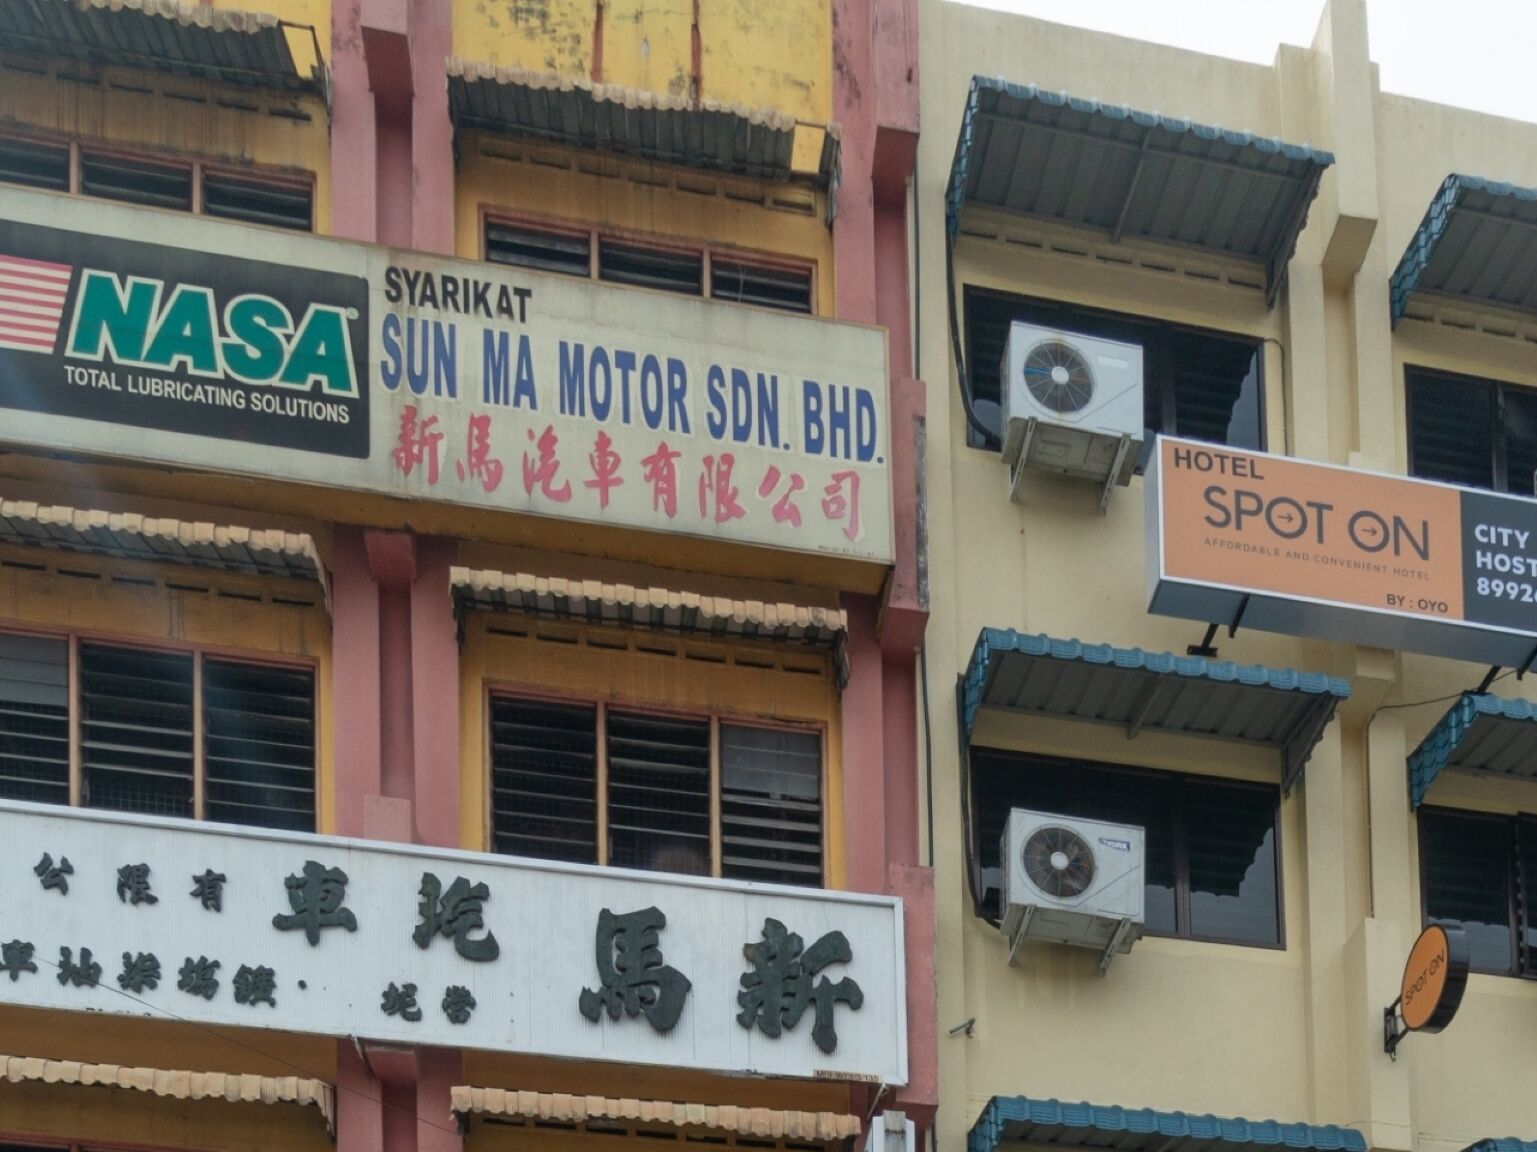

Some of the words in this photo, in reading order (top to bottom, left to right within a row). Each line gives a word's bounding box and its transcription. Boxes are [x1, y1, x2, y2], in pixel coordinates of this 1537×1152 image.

[385, 266, 532, 323] SYARIKAT
[65, 268, 359, 398] NASA
[64, 365, 122, 392] TOTAL
[128, 374, 247, 410] LUBRICATING
[250, 394, 350, 424] SOLUTIONS
[380, 313, 457, 399] SUN
[483, 328, 537, 410] MA
[559, 340, 692, 434] MOTOR
[707, 364, 791, 450] SDN.
[804, 380, 884, 464] BHD.
[1174, 447, 1264, 481] HOTEL
[1204, 486, 1333, 544] SPOT
[1348, 510, 1430, 561] ON
[1474, 523, 1531, 549] CITY
[1204, 537, 1281, 558] AFFORDABLE
[1286, 550, 1310, 561] AND
[1314, 554, 1388, 574] CONVENIENT
[1393, 567, 1431, 581] HOTEL
[1387, 593, 1406, 606] BY
[1417, 599, 1448, 613] OYO
[1405, 968, 1428, 1005] SPOT
[1429, 949, 1444, 976] ON
